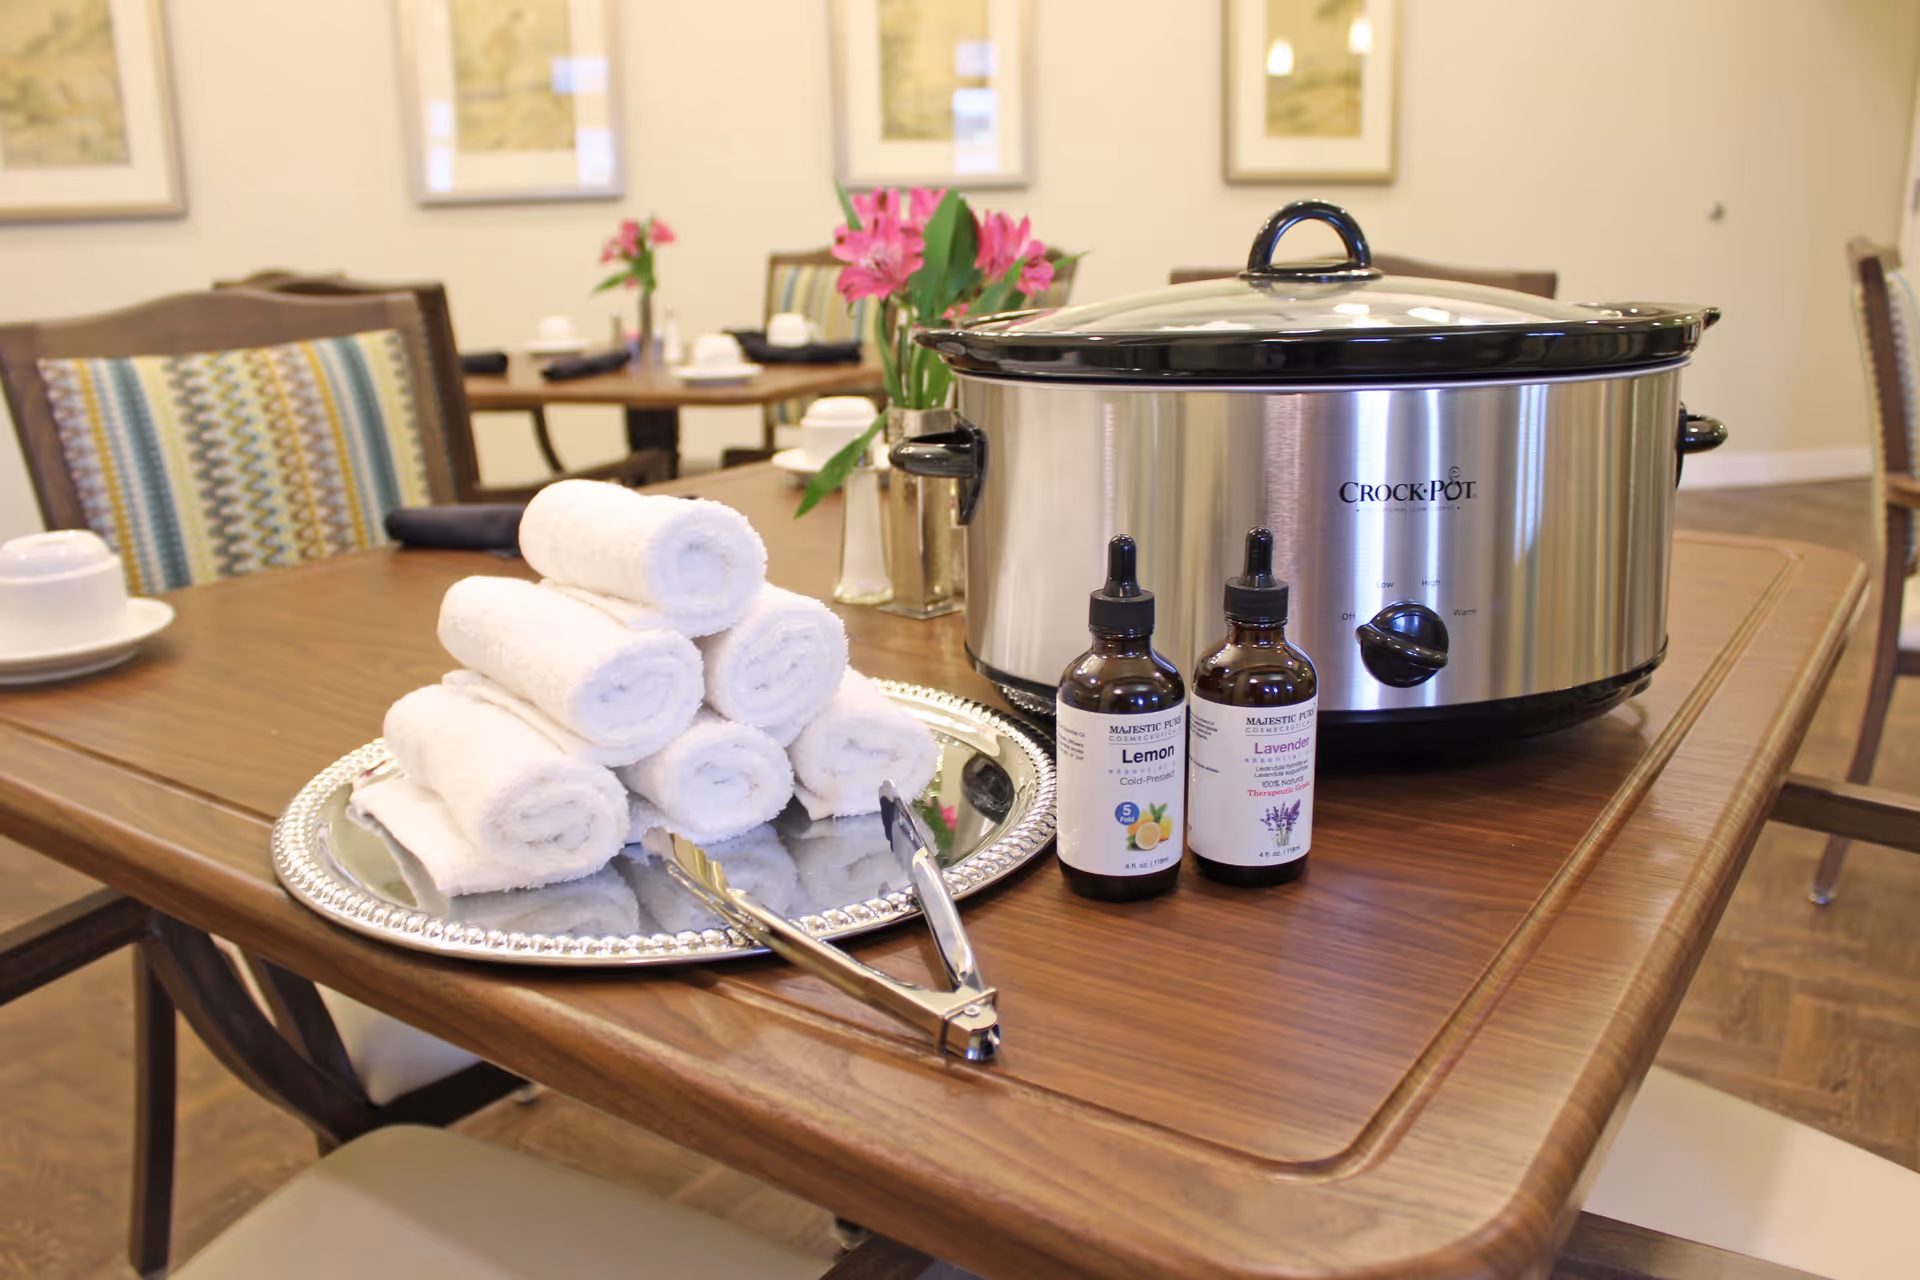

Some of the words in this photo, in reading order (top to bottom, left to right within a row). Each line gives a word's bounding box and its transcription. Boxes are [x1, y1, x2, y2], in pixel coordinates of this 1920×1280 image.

[1421, 579, 1440, 587] High
[1246, 714, 1296, 726] MAJESTIC
[1109, 723, 1161, 734] MAJESTIC
[1254, 737, 1310, 755] Lavender
[1122, 745, 1175, 764] Lemon
[1119, 770, 1175, 786] Cold-Pressed
[1261, 780, 1280, 788] 100%
[1247, 787, 1294, 797] Therapeutic
[1122, 804, 1131, 816] 5
